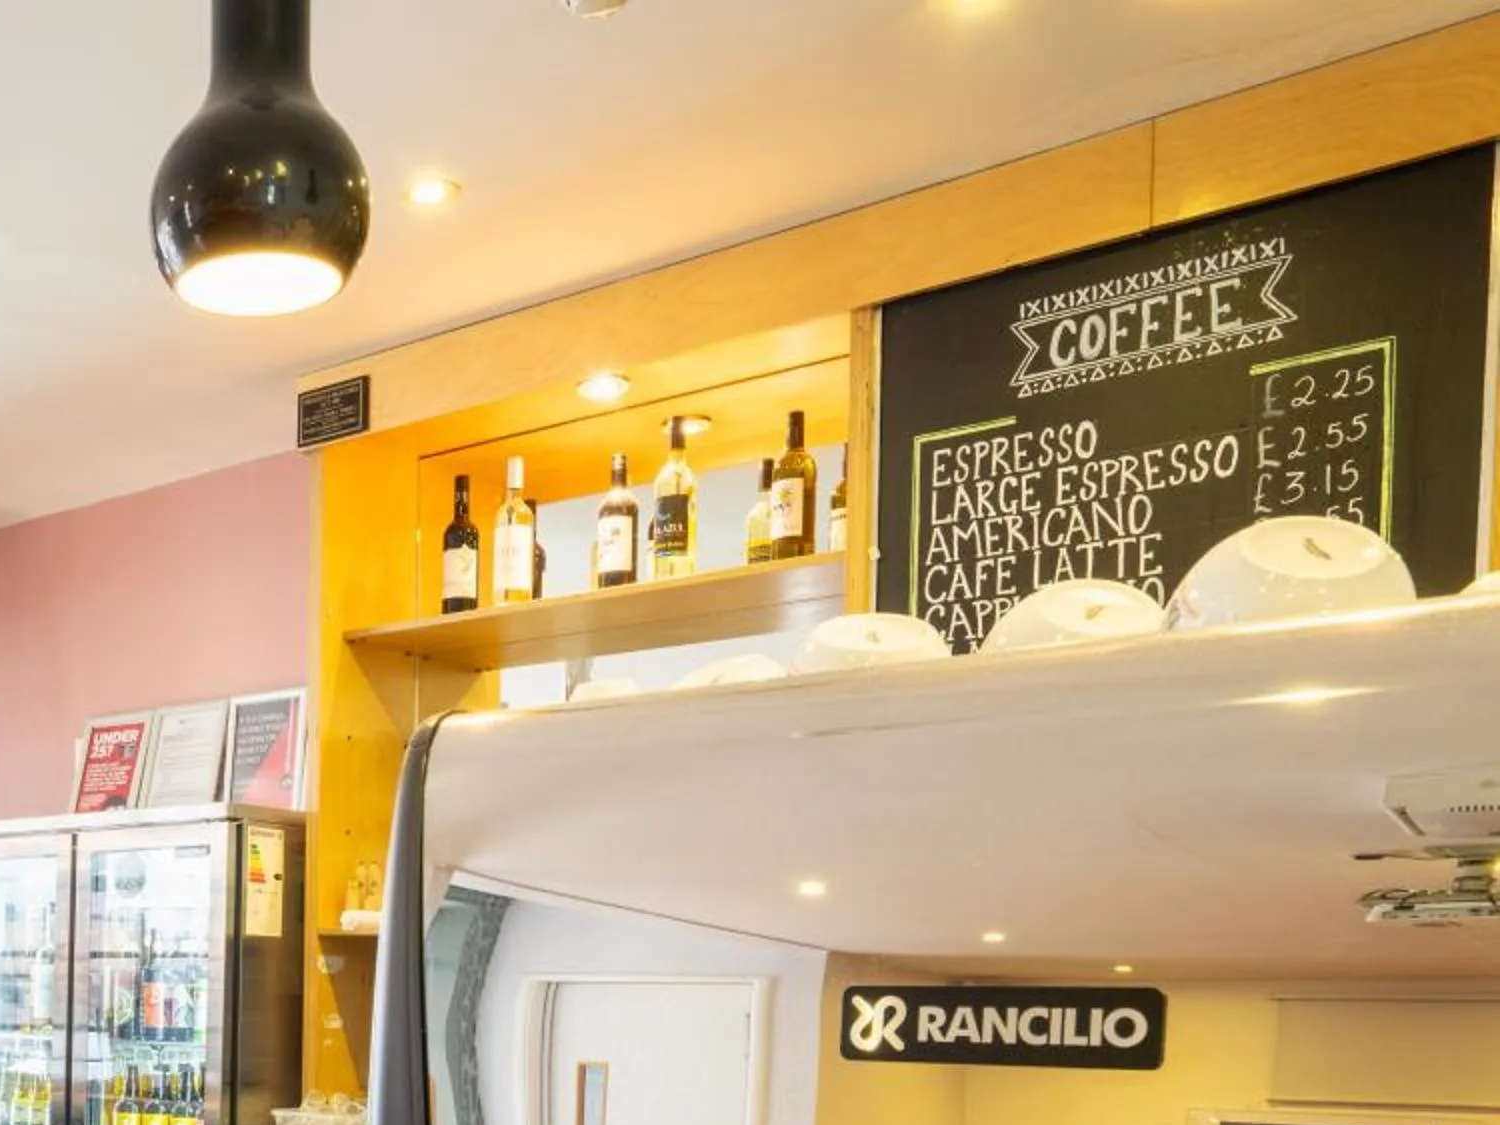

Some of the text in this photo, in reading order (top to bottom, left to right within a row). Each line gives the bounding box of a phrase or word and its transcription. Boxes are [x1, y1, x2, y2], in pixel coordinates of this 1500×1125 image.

[1049, 277, 1243, 369] COFFEE
[931, 471, 1041, 526] LARGE
[1056, 434, 1239, 505] ESPRESSO
[932, 420, 1098, 488] ESPRESSO
[925, 493, 1153, 566] AMERICANO
[924, 532, 1164, 605] CAFE LATTE
[92, 728, 141, 747] UNDER
[917, 1005, 1149, 1048] RANCILIO
